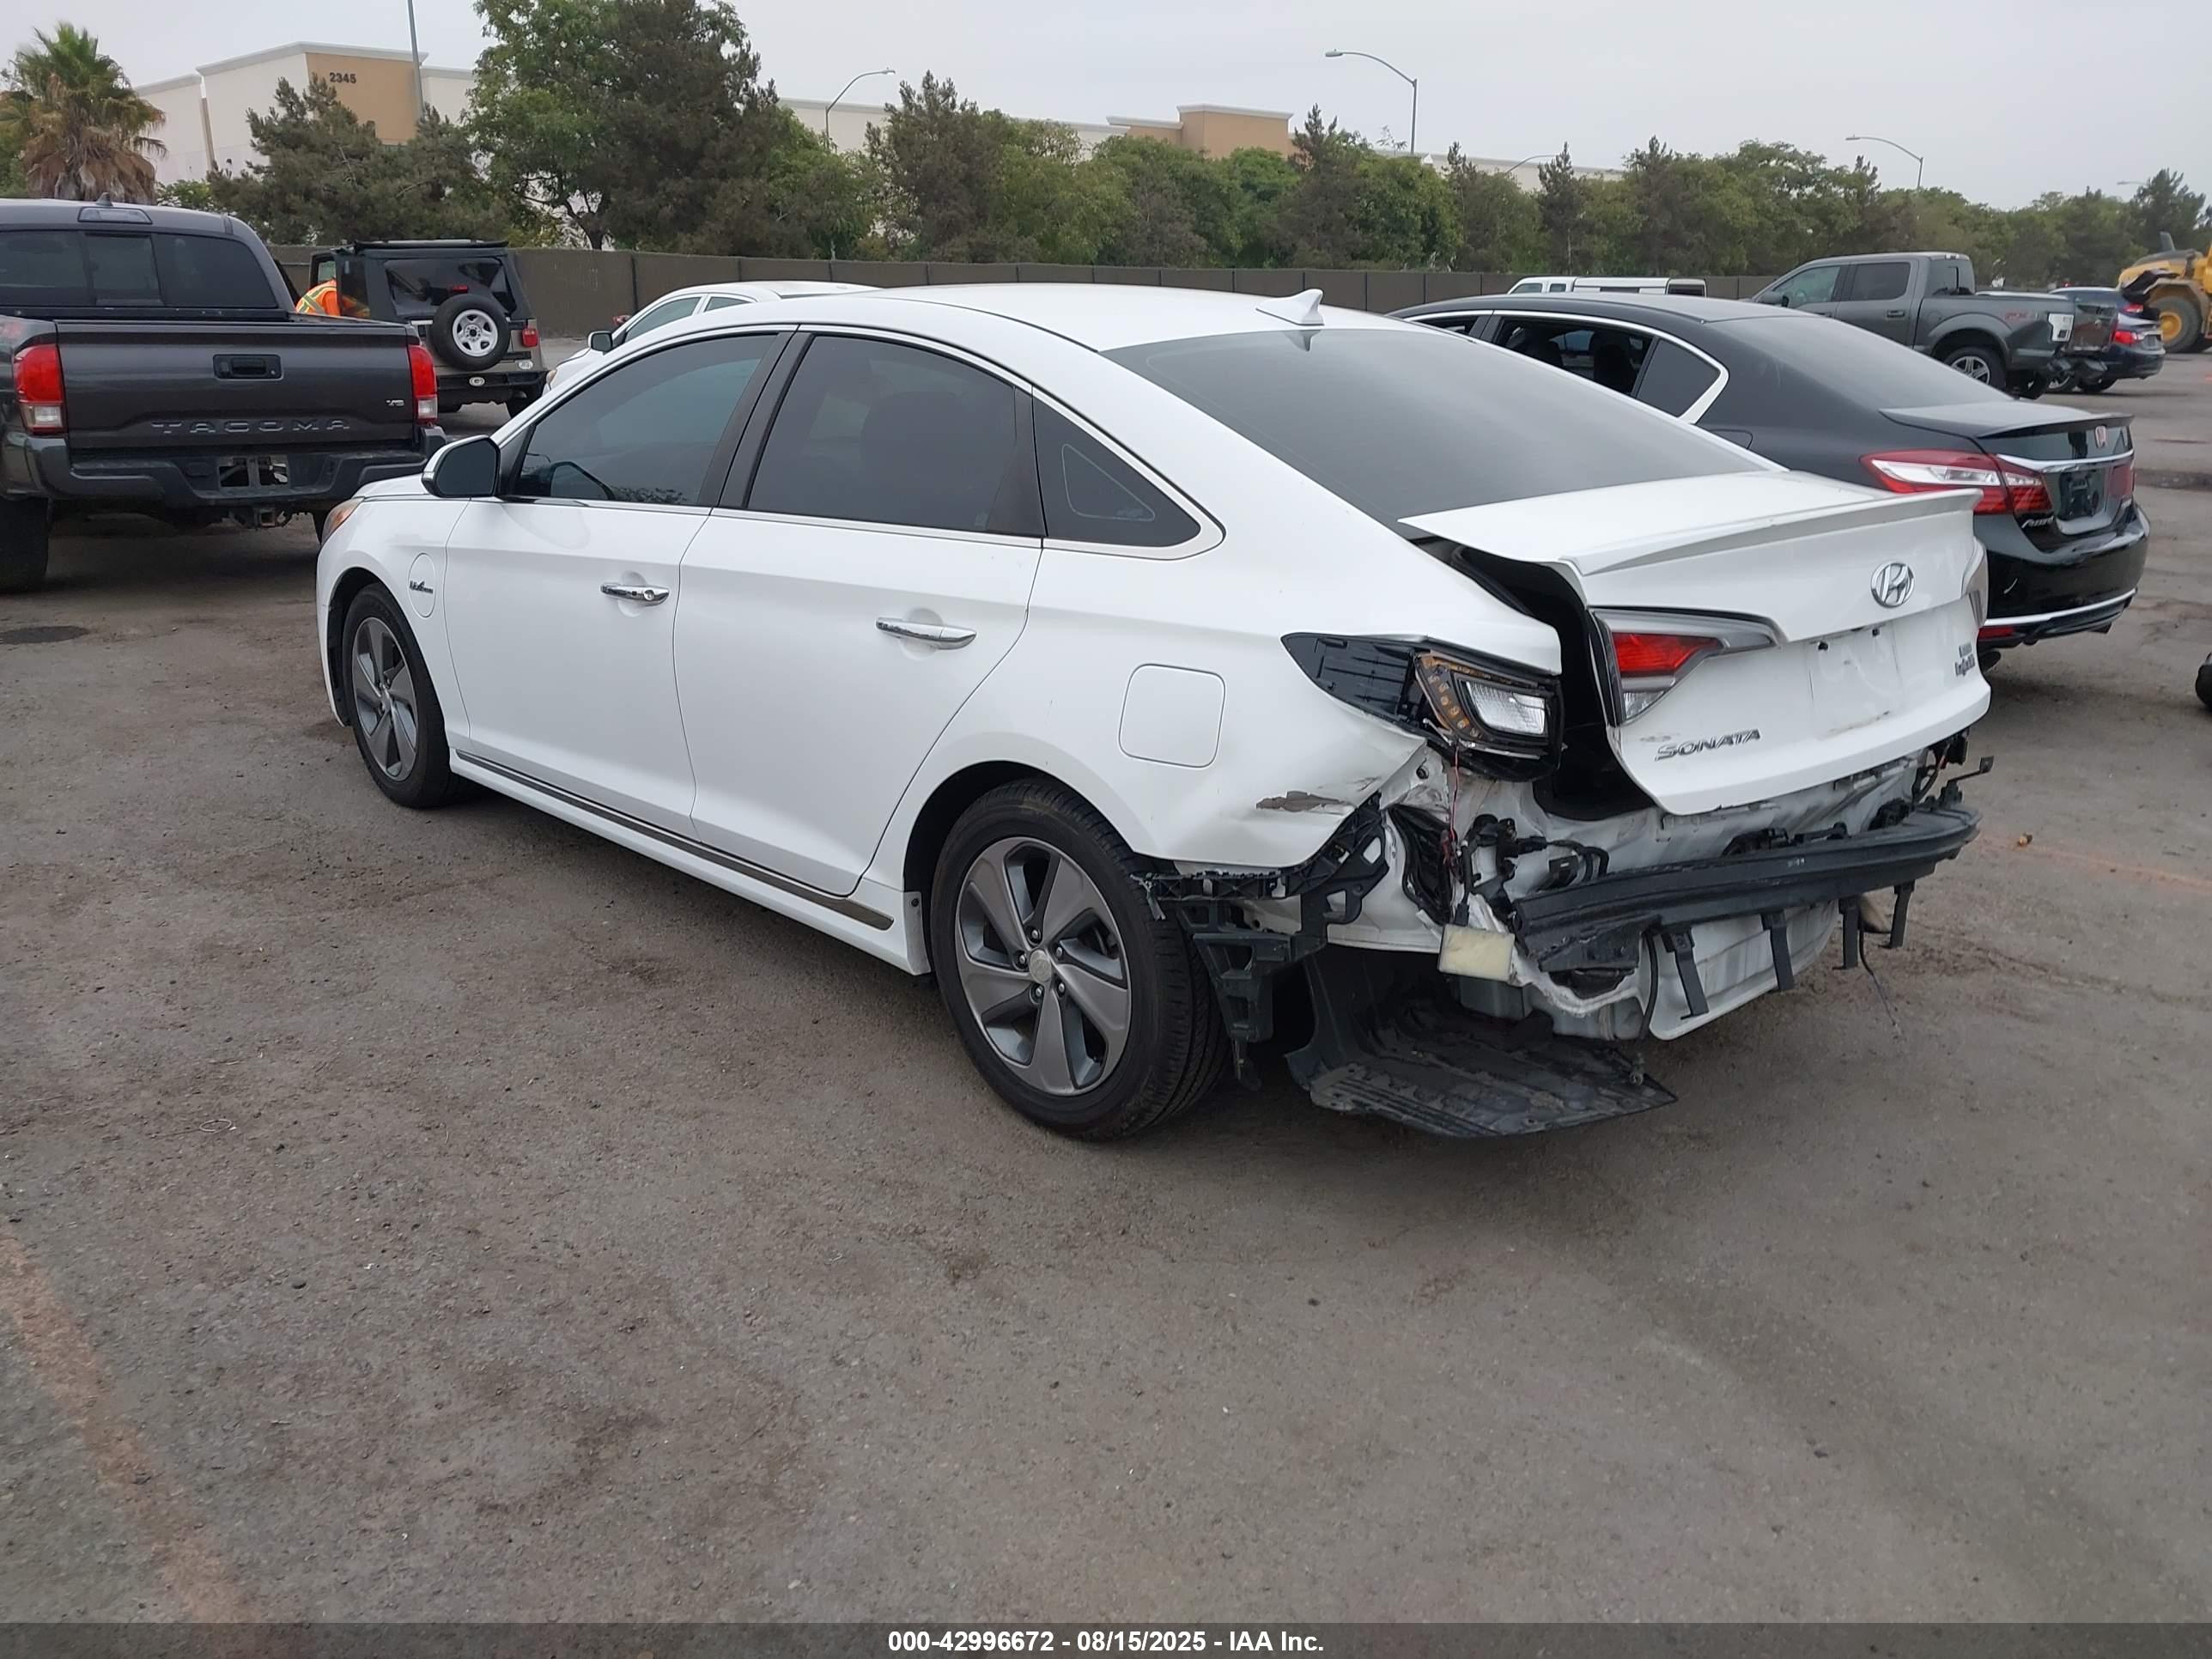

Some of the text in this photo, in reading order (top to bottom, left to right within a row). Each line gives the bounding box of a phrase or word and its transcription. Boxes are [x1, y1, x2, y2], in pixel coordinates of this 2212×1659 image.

[329, 72, 357, 84] 2345
[151, 419, 350, 434] TACOMA
[1654, 728, 1761, 762] SONATA
